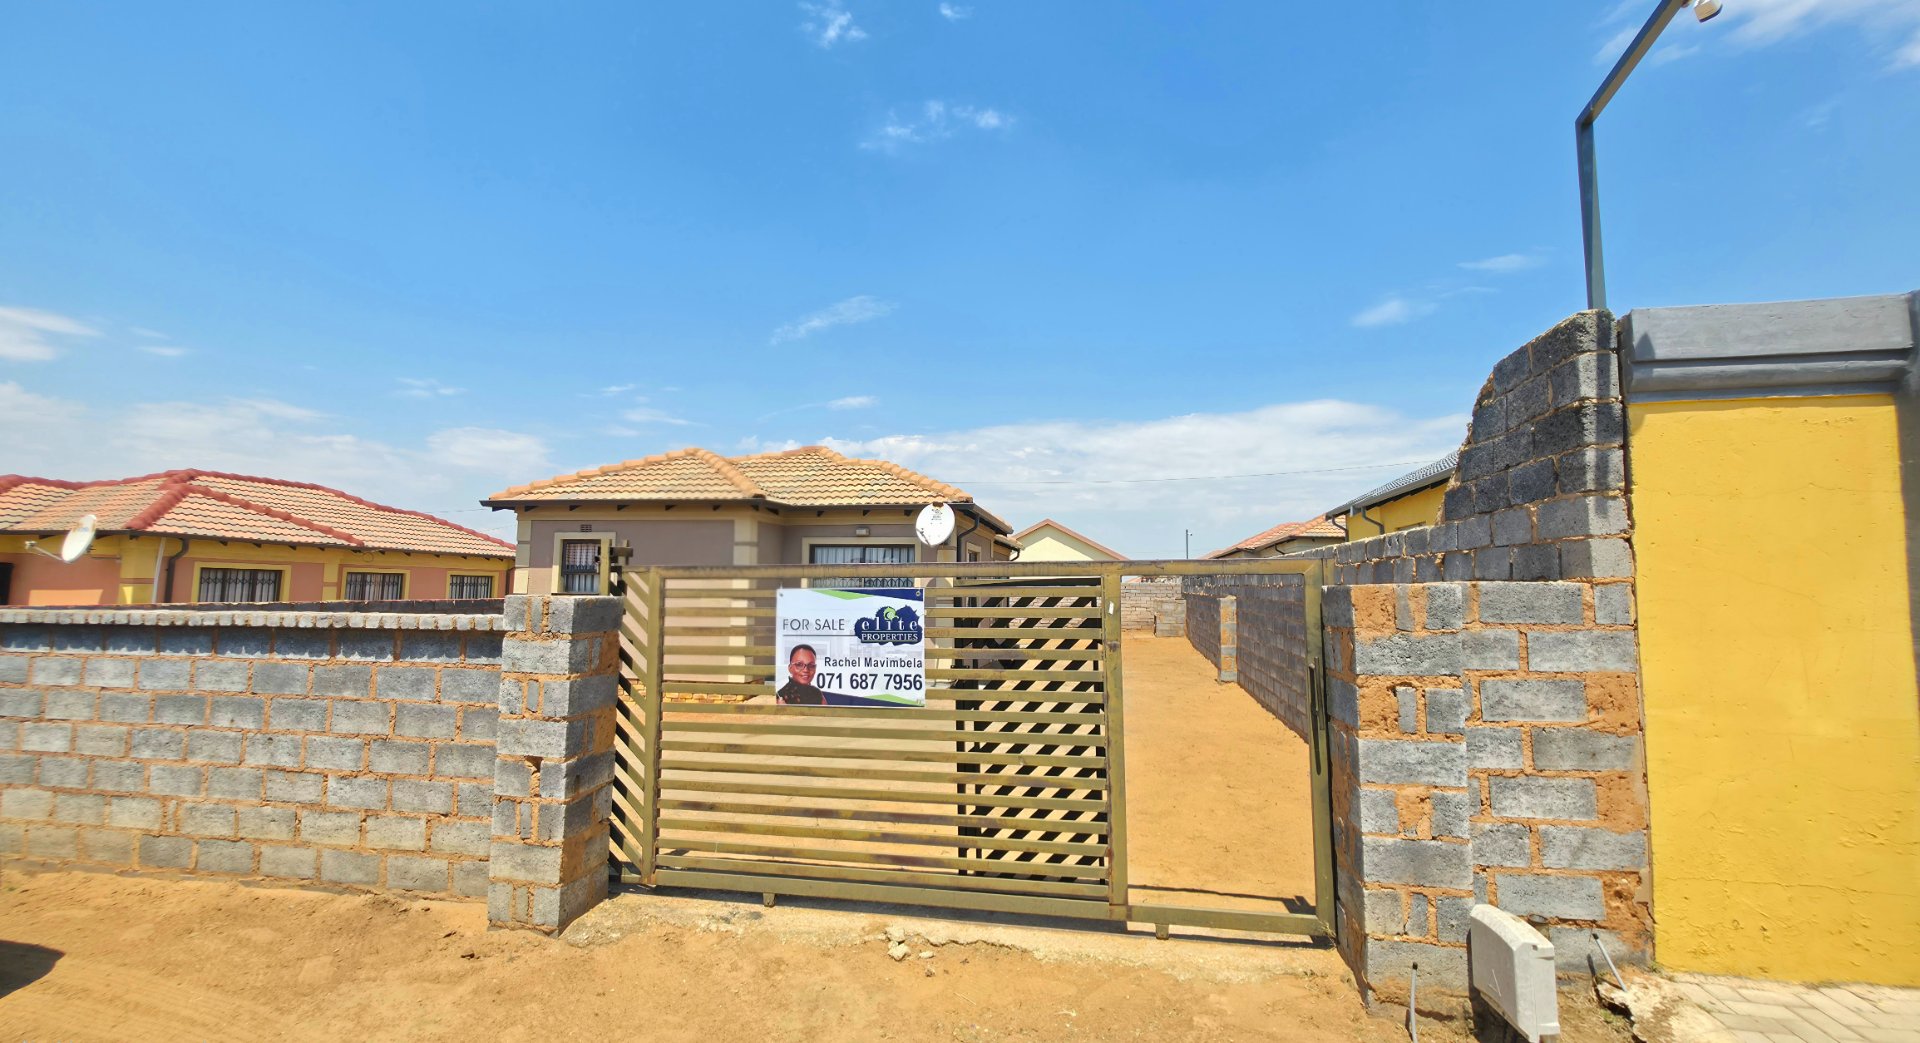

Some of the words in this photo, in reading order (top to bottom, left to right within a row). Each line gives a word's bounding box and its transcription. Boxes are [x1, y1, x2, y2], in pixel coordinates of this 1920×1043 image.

[783, 618, 809, 630] FOR
[814, 618, 845, 631] SALE
[861, 616, 918, 631] elite
[861, 633, 918, 641] PROPERTIES
[824, 656, 861, 667] Rachel
[864, 657, 923, 668] Mavimbela
[816, 672, 843, 689] 071
[850, 673, 878, 690] 687
[883, 673, 923, 691] 7956
